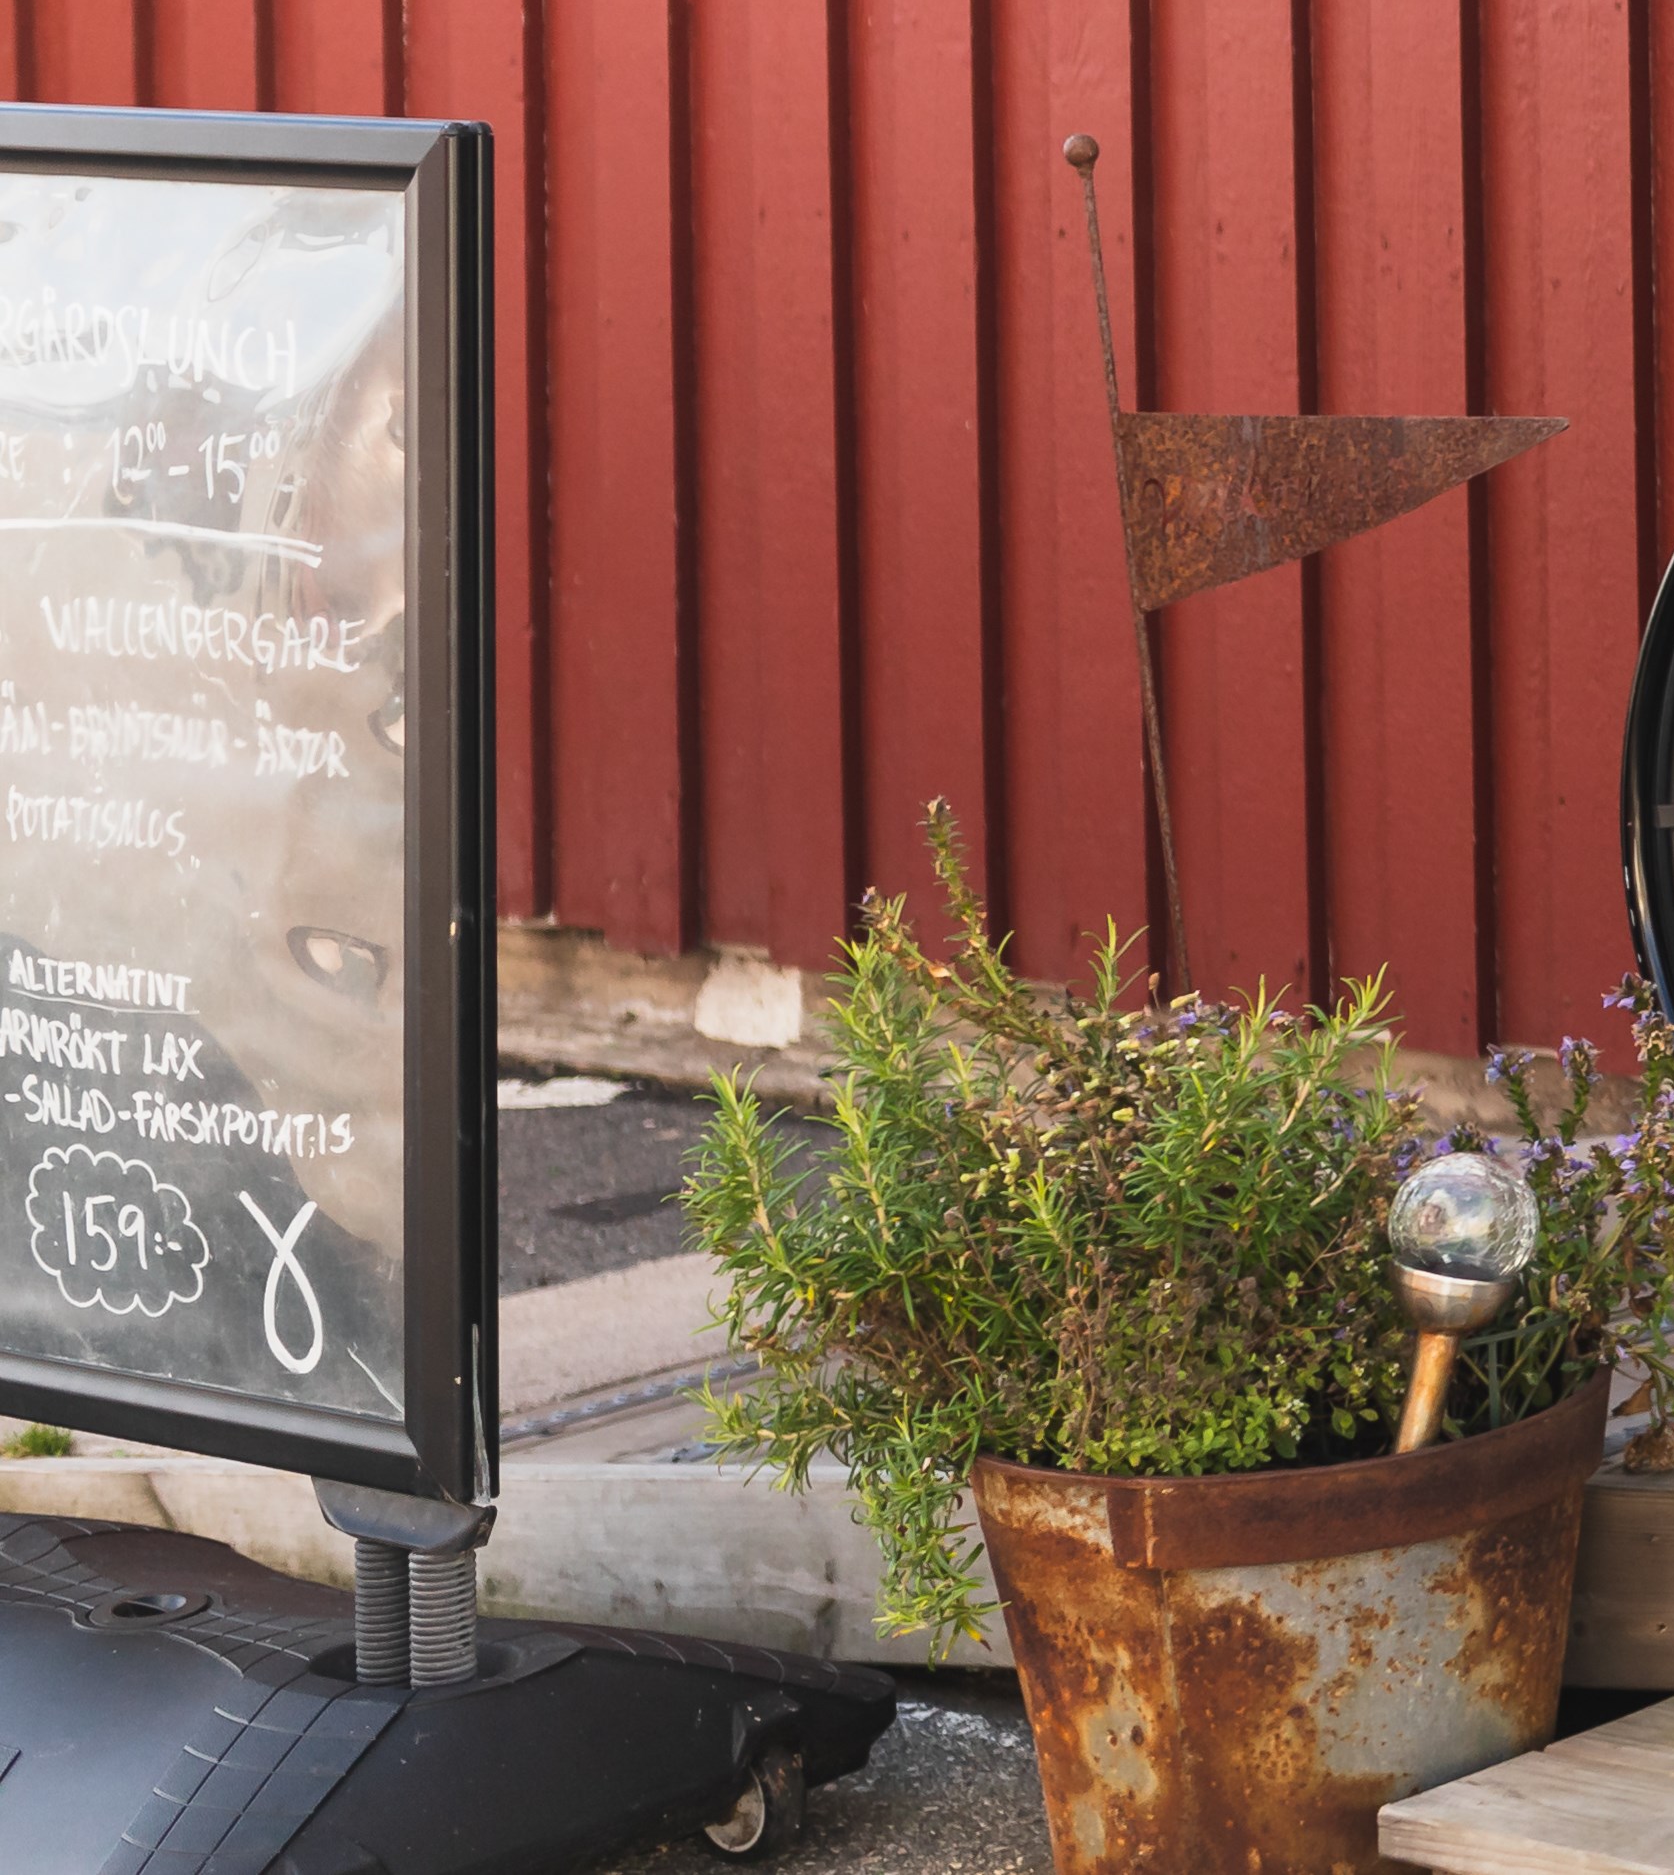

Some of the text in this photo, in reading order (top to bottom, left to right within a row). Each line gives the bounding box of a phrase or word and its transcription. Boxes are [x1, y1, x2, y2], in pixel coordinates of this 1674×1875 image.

[40, 594, 366, 674] WALLENBERGARE
[5, 783, 187, 857] POTATISMOS
[143, 1031, 205, 1082] LAX
